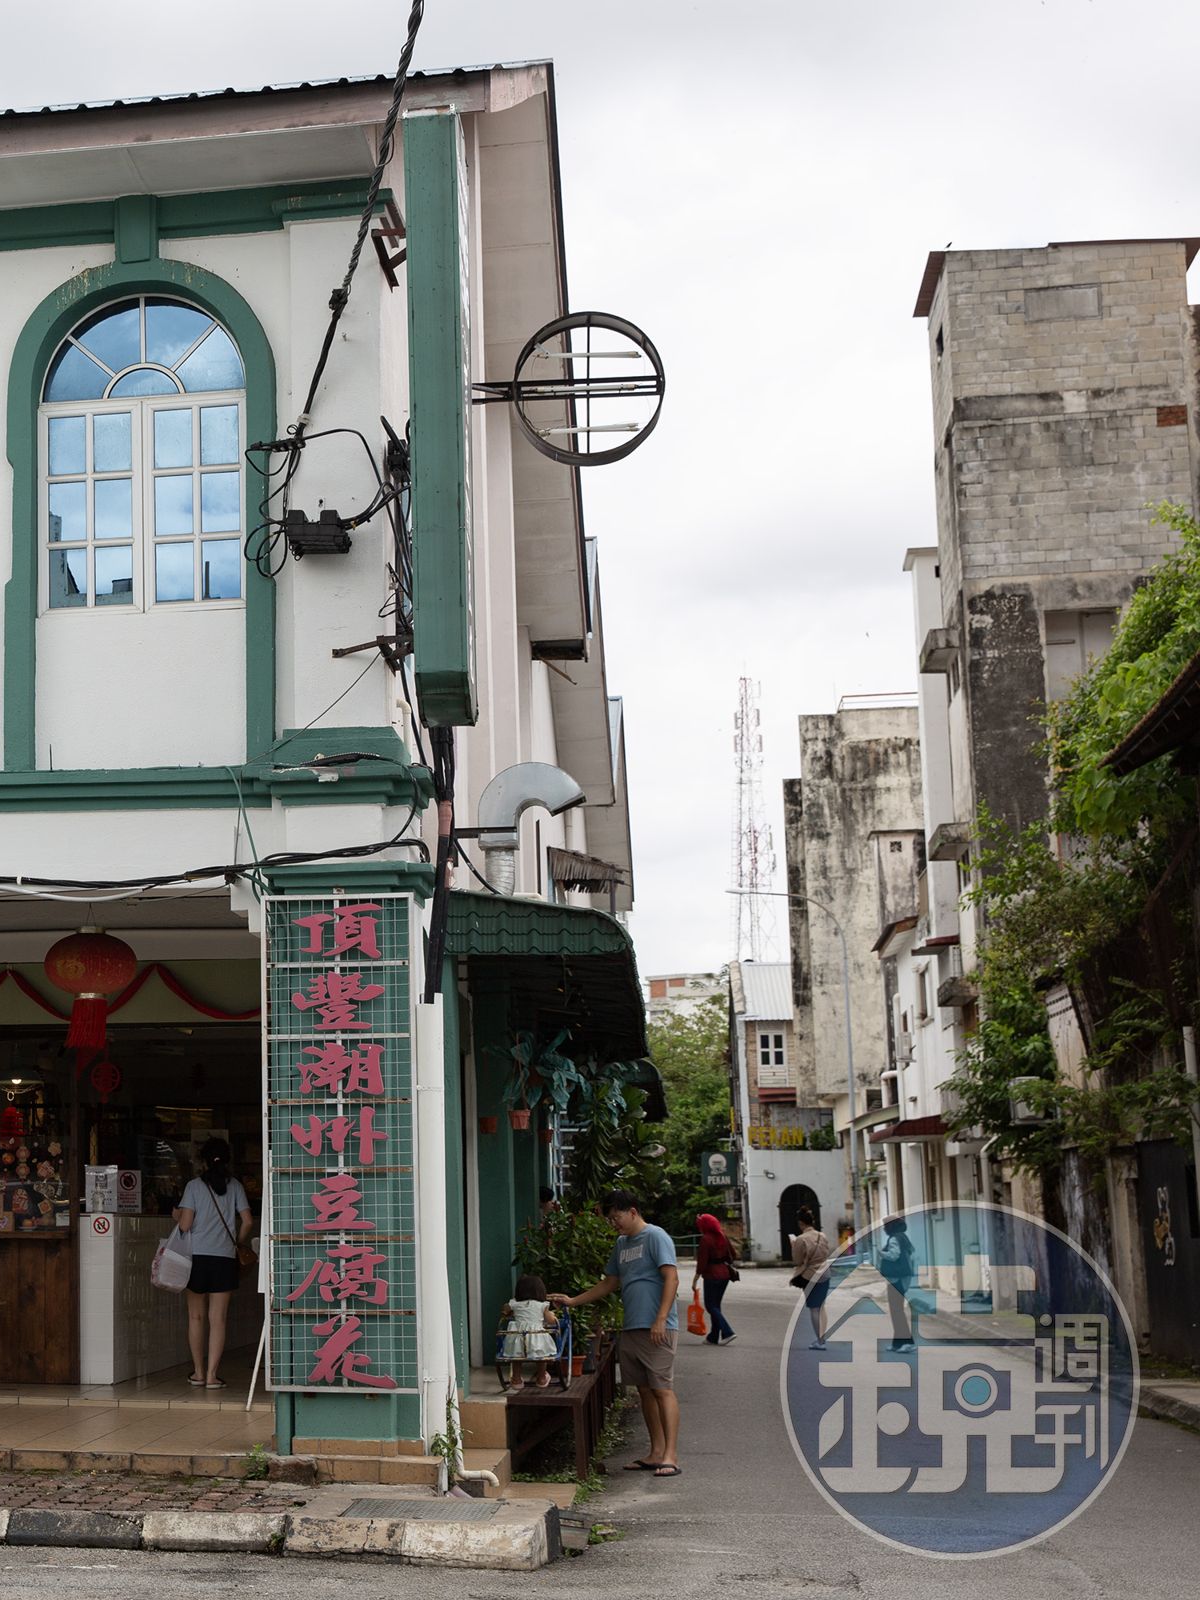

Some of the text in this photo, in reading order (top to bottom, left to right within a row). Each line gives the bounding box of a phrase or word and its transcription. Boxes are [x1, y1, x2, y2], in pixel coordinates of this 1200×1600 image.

[285, 902, 399, 1389] 頂豐潮州豆腐花
[747, 1126, 805, 1147] PEKAN
[707, 1175, 731, 1186] PEKAN
